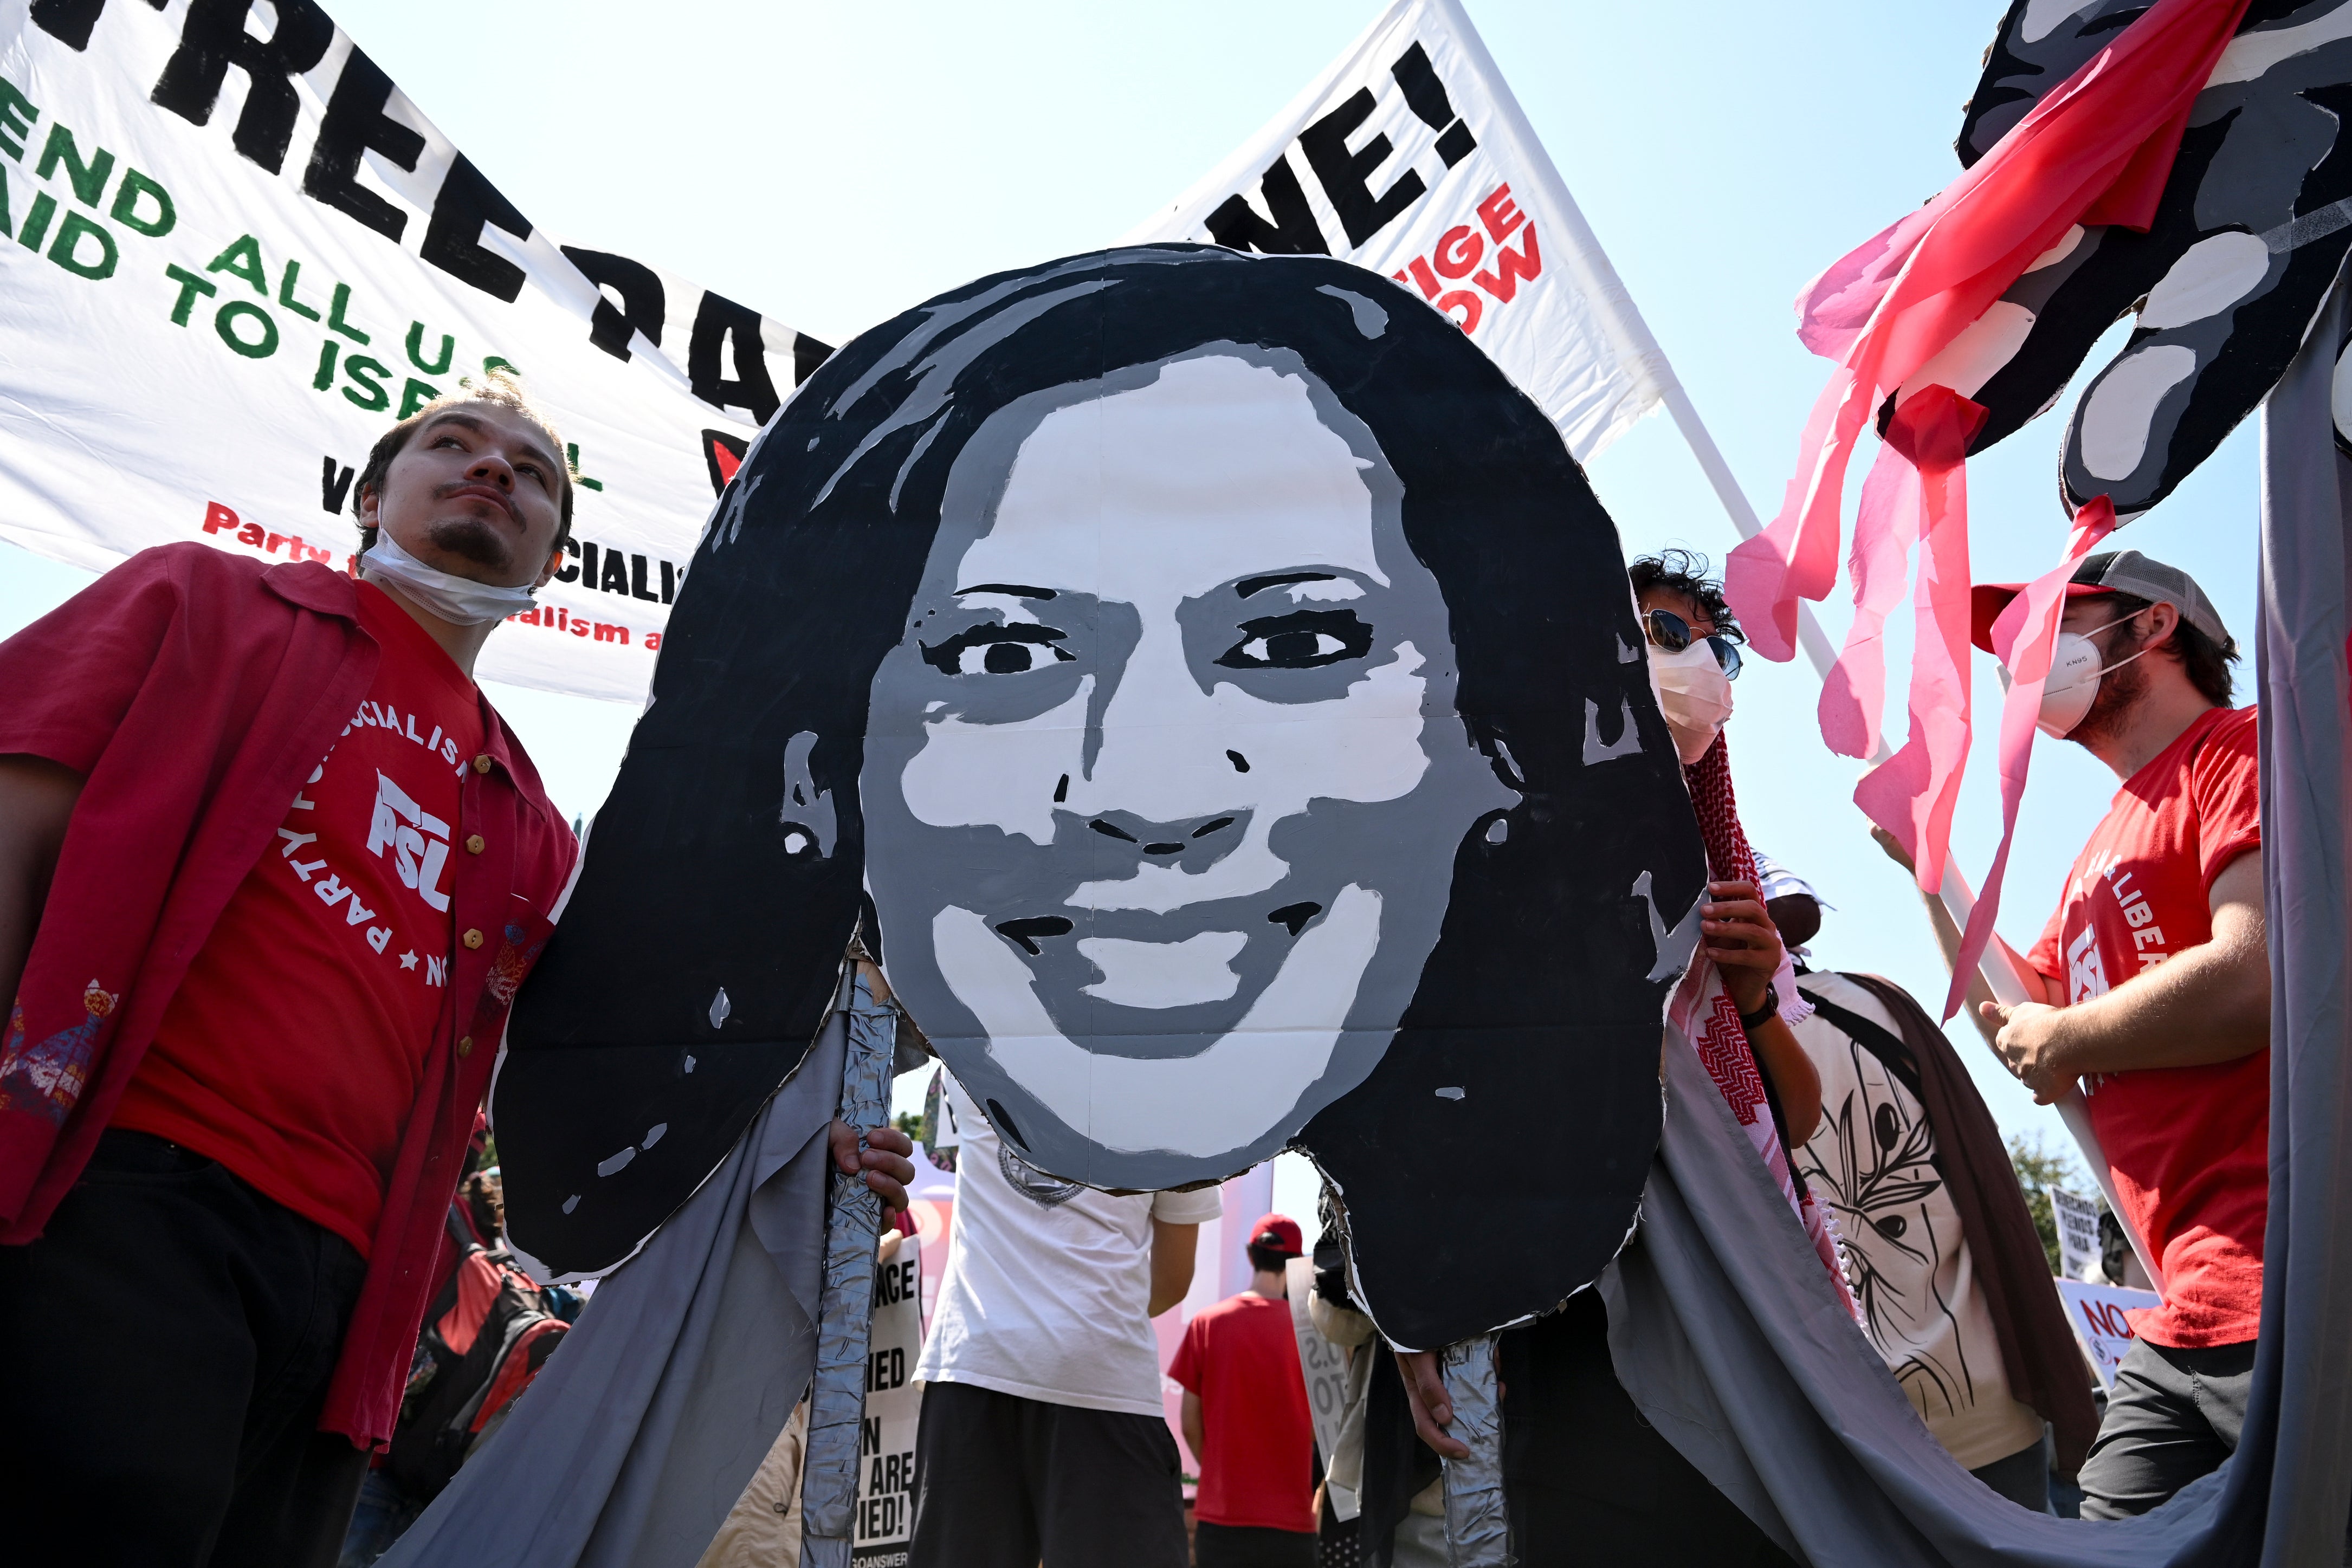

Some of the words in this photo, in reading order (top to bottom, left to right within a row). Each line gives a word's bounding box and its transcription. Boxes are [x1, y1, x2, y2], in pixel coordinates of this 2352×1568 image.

[1204, 40, 1477, 256] NE!
[206, 234, 370, 346] ALL
[1392, 182, 1526, 301] IGE
[1437, 220, 1542, 335] OW
[165, 263, 279, 359] TO
[560, 244, 837, 427] PA
[2066, 656, 2088, 668] KN95
[277, 826, 393, 955] PARTY
[366, 789, 450, 913] PSL
[869, 1451, 914, 1496] ARE
